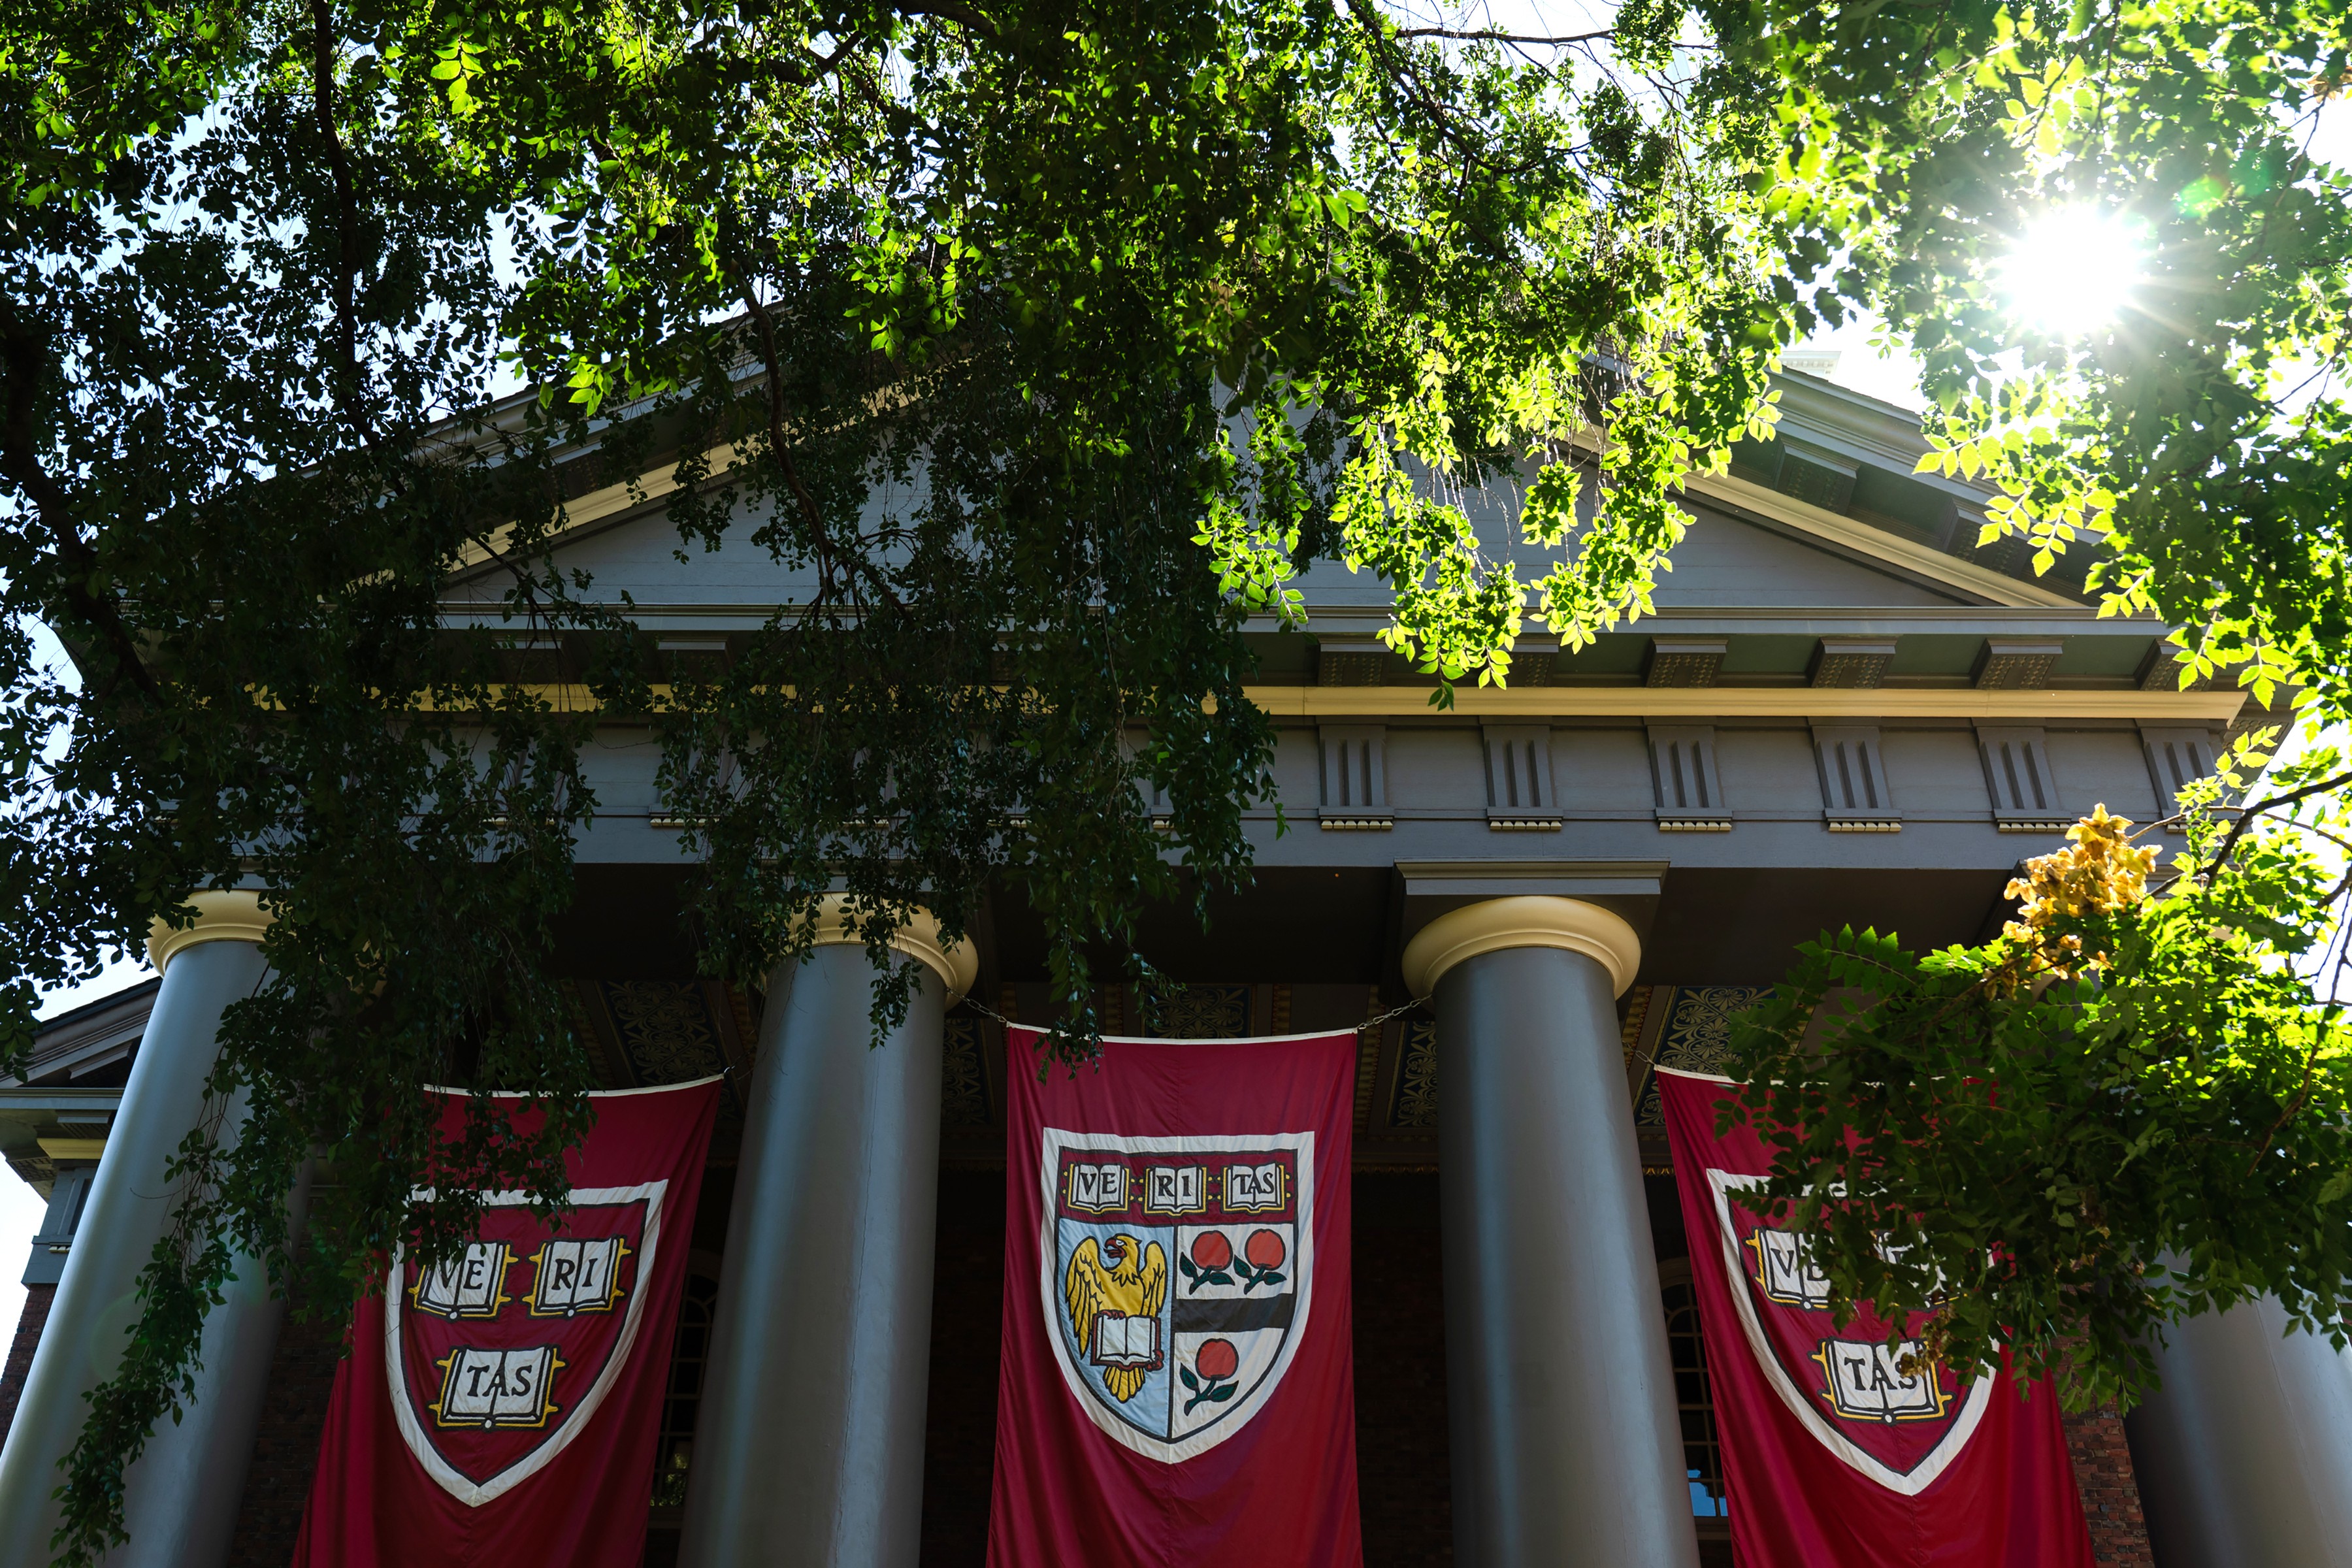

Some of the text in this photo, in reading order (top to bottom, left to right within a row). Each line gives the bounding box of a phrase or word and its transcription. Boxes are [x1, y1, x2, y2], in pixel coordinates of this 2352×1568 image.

[1080, 1172, 1275, 1197] VE RI TAS
[551, 1258, 598, 1290] RI
[467, 1365, 532, 1397] TAS
[1844, 1356, 1918, 1391] TAS
